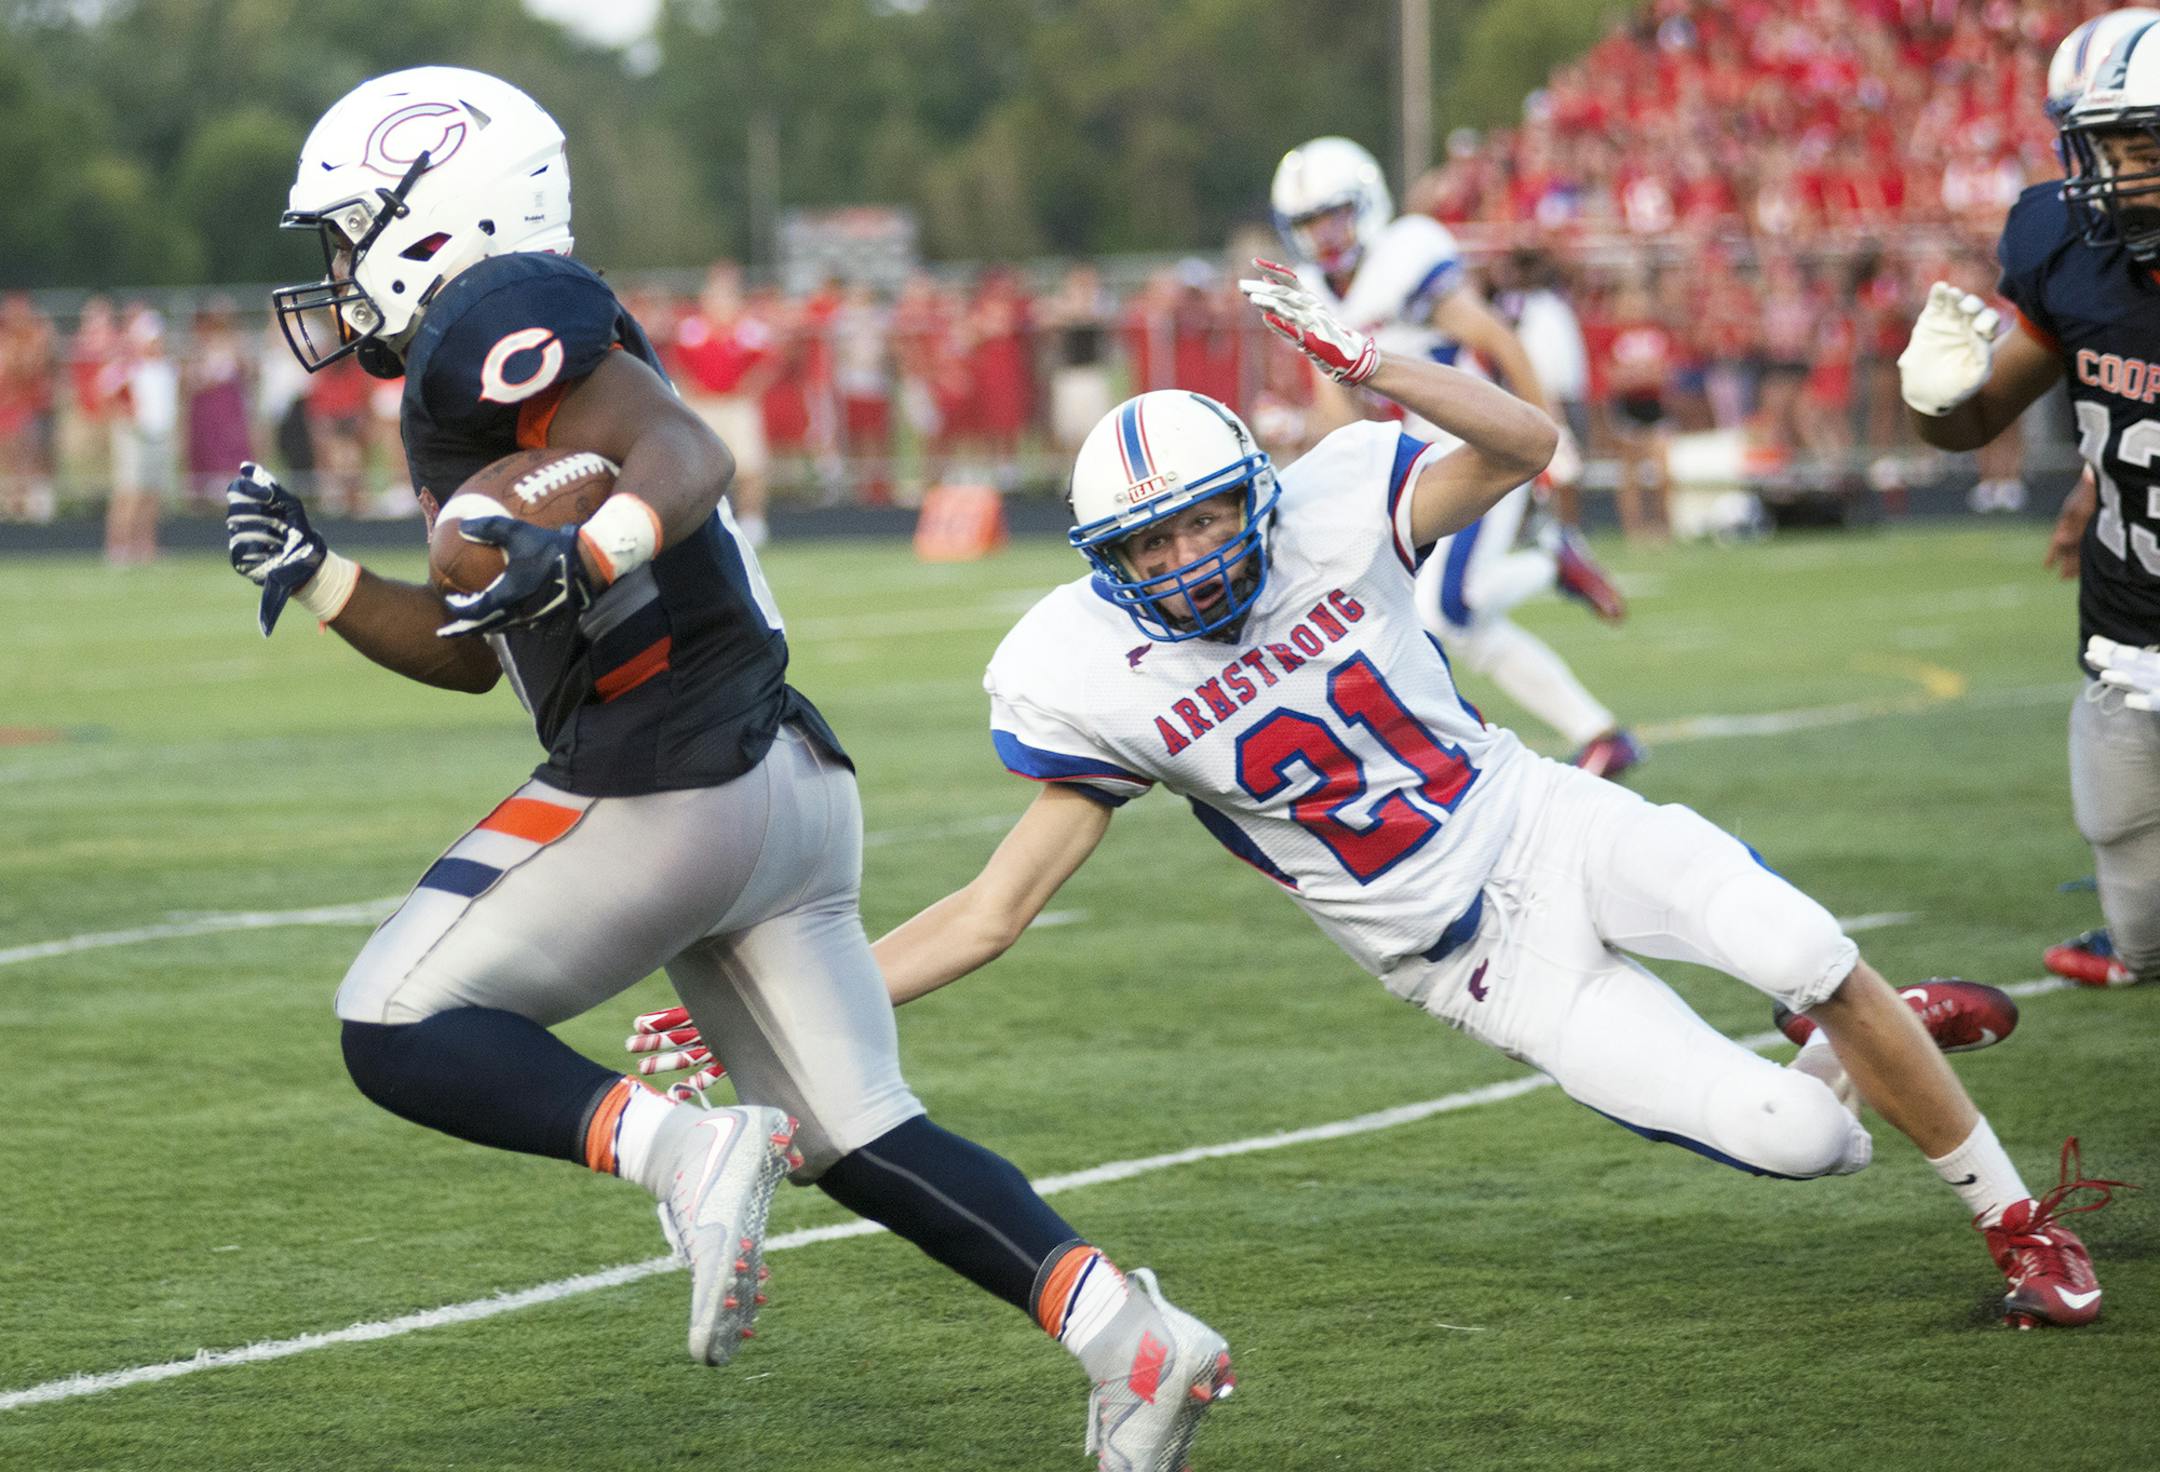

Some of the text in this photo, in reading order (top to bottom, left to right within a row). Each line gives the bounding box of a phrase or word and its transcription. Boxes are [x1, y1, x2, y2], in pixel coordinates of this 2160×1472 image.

[361, 102, 466, 178] C
[479, 327, 564, 403] C
[1153, 588, 1365, 757] ARMSTRONG
[1234, 649, 1482, 887] 21
